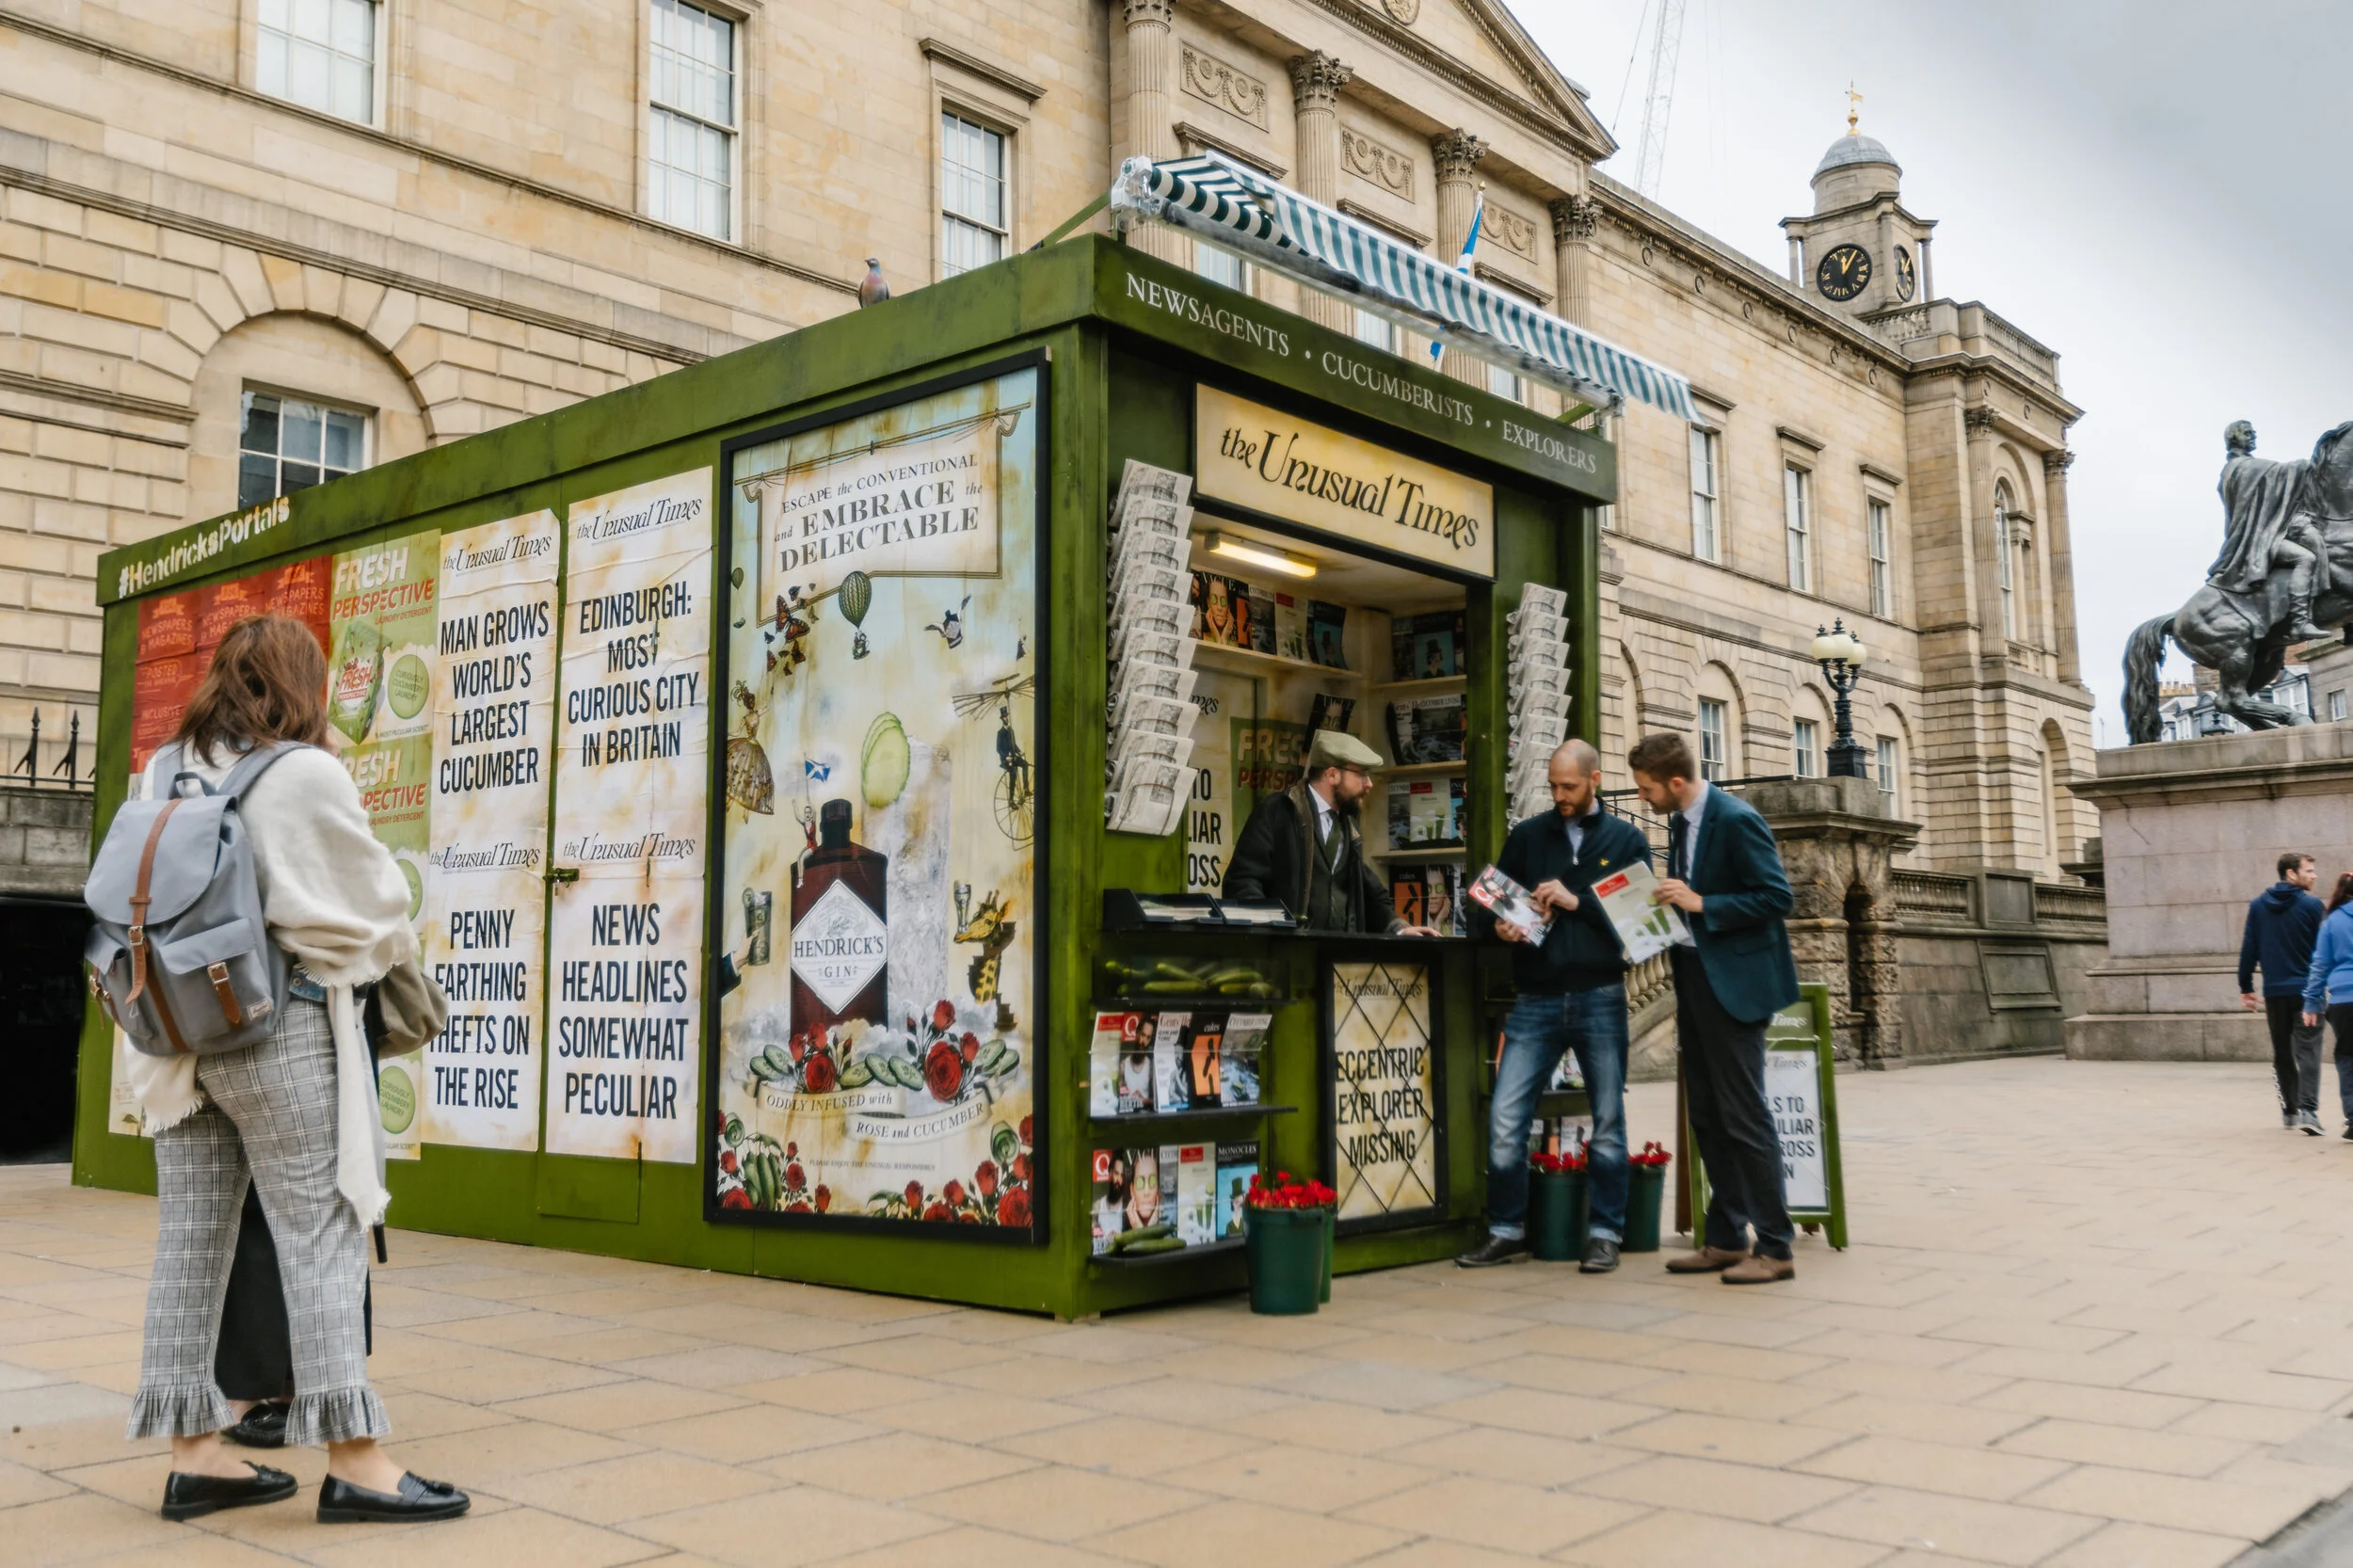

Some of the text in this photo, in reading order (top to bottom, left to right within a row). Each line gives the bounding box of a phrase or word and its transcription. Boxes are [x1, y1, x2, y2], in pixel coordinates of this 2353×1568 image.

[1126, 272, 1597, 474] NEWSAGENTS CUCUMBERISTS EXPLORERS
[781, 453, 979, 515] ESCAPE the CONVENTIONAL
[1220, 425, 1480, 551] the Unusual Times
[577, 521, 593, 540] the
[591, 499, 656, 542] Unusual
[653, 497, 703, 526] Times
[774, 480, 984, 543] and EMBRACE the
[118, 495, 291, 600] #HendricksPortals
[442, 553, 457, 571] the
[456, 536, 509, 573] Unusual
[509, 533, 552, 562] Times
[779, 505, 980, 574] DELECTABLE
[333, 546, 409, 596] FRESH
[265, 586, 325, 612] NEWSPAPERS
[331, 578, 436, 621] PERSPECTIVE
[399, 605, 433, 620] DETERGENT
[580, 580, 693, 635] EDINBURGH:
[440, 600, 550, 657] MAN GROWS
[606, 629, 661, 674] MOST
[340, 664, 375, 692] FRESH
[452, 650, 533, 700] WORLD'S
[568, 670, 700, 726] CURIOUS CITY
[1192, 695, 1220, 715] mes
[451, 699, 531, 747] LARGEST
[582, 721, 681, 768] IN BRITAIN
[1238, 728, 1305, 766] FRES
[342, 749, 403, 791] RESH
[440, 746, 539, 795] CUCUMBER
[362, 782, 427, 812] PECTIVE
[392, 809, 425, 824] DETERGENT
[428, 841, 541, 870] the Unusual Times
[563, 832, 696, 861] the Unusual Times
[450, 908, 516, 951] PENNY
[591, 902, 662, 947] NEWS
[793, 935, 884, 958] HENDRICK'S
[435, 961, 527, 1002] FARTHING
[562, 959, 689, 1004] HEADLINES
[824, 965, 853, 979] GIN
[429, 1015, 530, 1056] HEFTS ON
[558, 1016, 690, 1062] SOMEWHAT
[1335, 1046, 1425, 1083] ECCENTRIC
[434, 1066, 520, 1110] THE RISE
[565, 1072, 678, 1120] PECULIAR
[766, 1093, 893, 1112] ODDLY INFUSED with
[1338, 1088, 1425, 1126] EXPLORER
[1786, 1096, 1805, 1113] TO
[856, 1121, 890, 1139] ROSE
[913, 1101, 984, 1139] CUCUMBER
[1095, 1152, 1110, 1176] Q
[1349, 1129, 1417, 1168] MISSING
